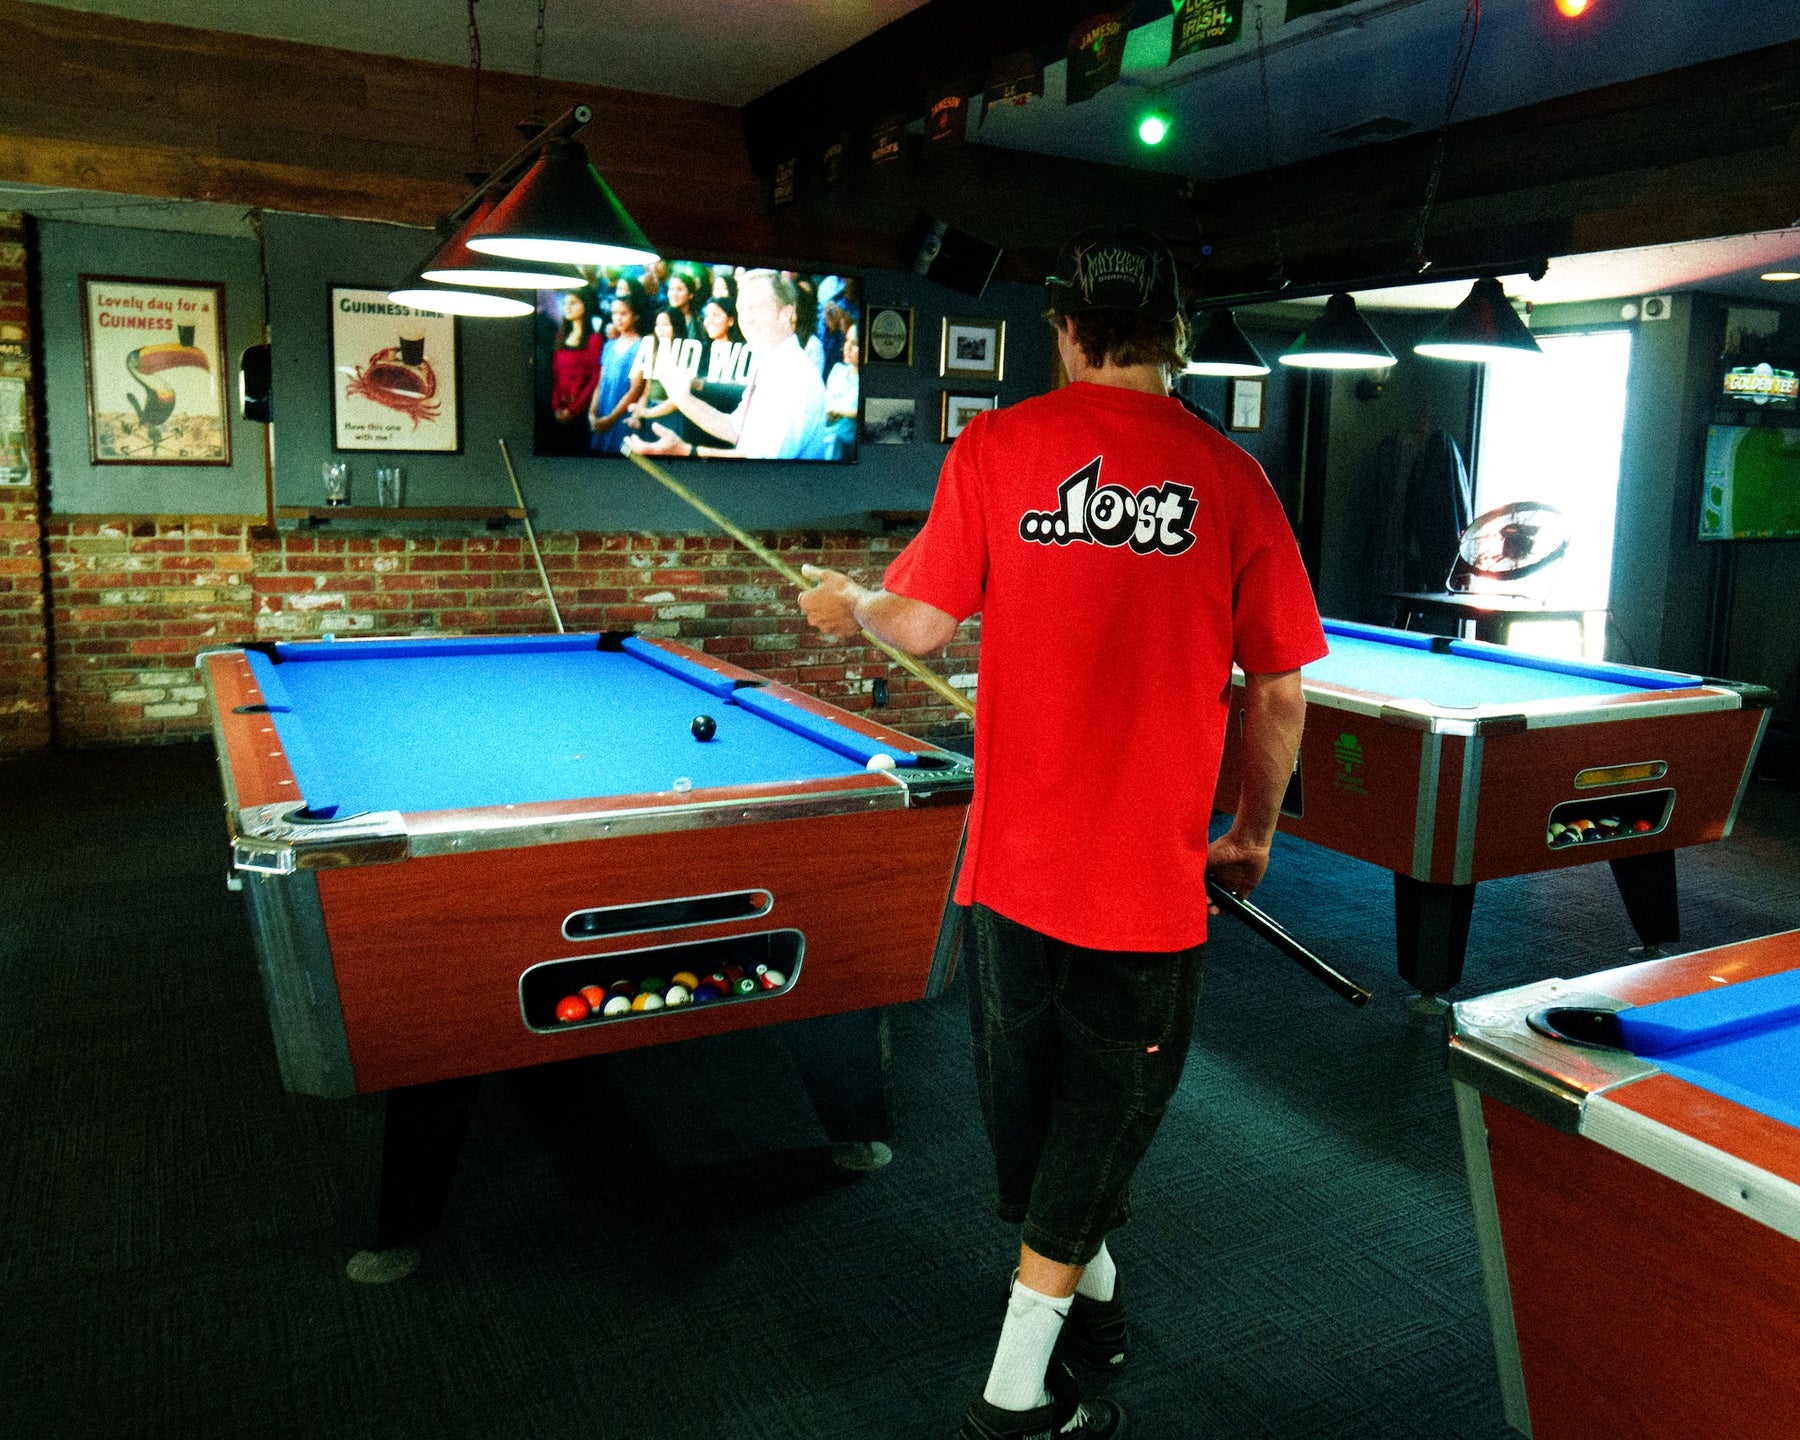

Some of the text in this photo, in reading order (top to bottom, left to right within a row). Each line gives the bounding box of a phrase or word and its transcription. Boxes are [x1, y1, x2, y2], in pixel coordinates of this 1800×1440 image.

[1182, 5, 1226, 40] IRISH
[1085, 247, 1148, 293] MAYHEM
[97, 295, 210, 313] Lovely day for a
[339, 298, 410, 316] GUINNESS
[98, 312, 173, 330] GUINNESS
[627, 335, 703, 381] AND
[1731, 376, 1793, 392] GOLDEN TEE
